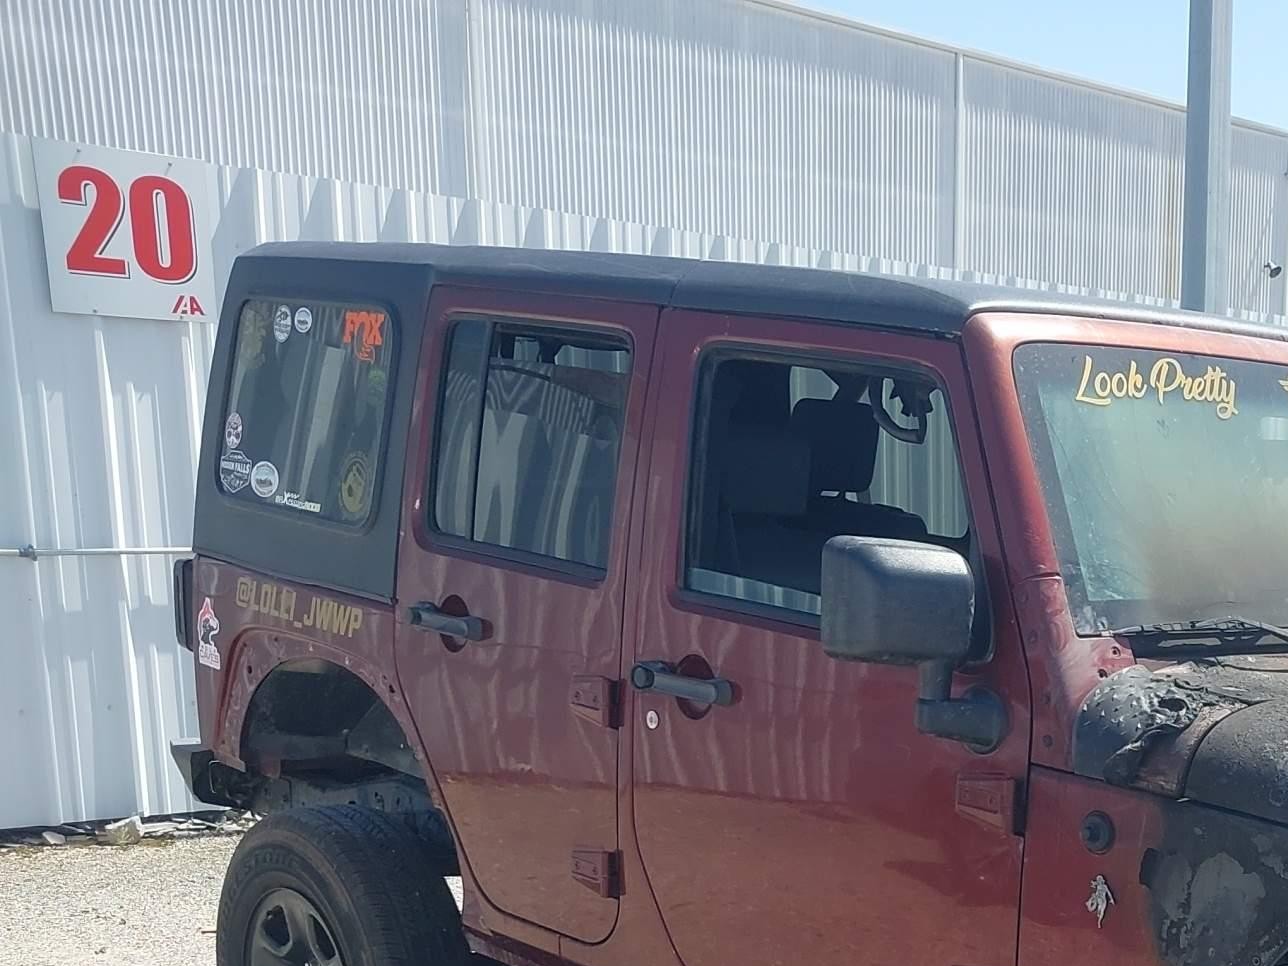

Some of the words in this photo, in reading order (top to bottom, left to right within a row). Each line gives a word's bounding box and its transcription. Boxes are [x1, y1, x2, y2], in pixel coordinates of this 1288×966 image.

[58, 164, 197, 284] 20
[343, 311, 385, 346] FOX
[1075, 354, 1148, 406] Look
[1150, 357, 1239, 420] Pretty
